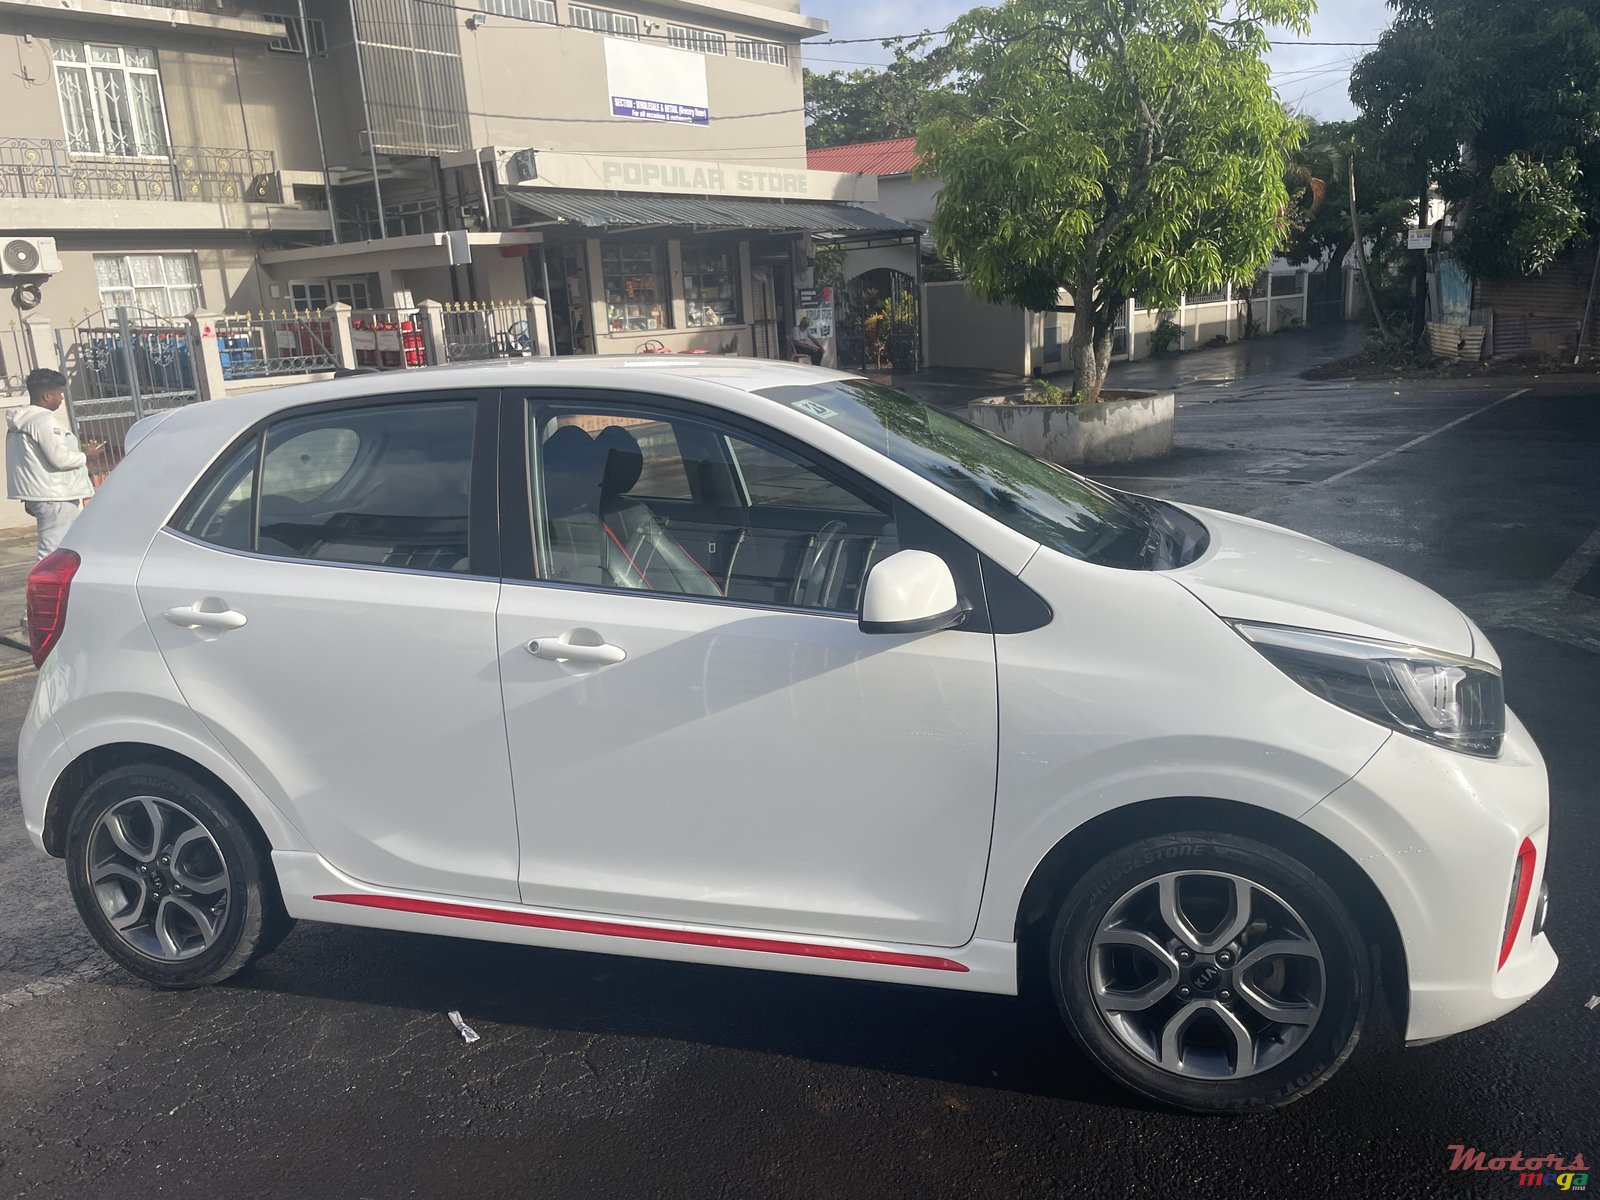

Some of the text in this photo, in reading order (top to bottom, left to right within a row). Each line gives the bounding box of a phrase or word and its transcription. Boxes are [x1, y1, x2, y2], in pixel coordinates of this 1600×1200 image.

[636, 101, 660, 112] WHOLESALE
[664, 104, 678, 113] RETAIL
[602, 161, 807, 193] POPULAR STORE
[151, 870, 163, 889] KIA
[1193, 966, 1218, 988] KIA
